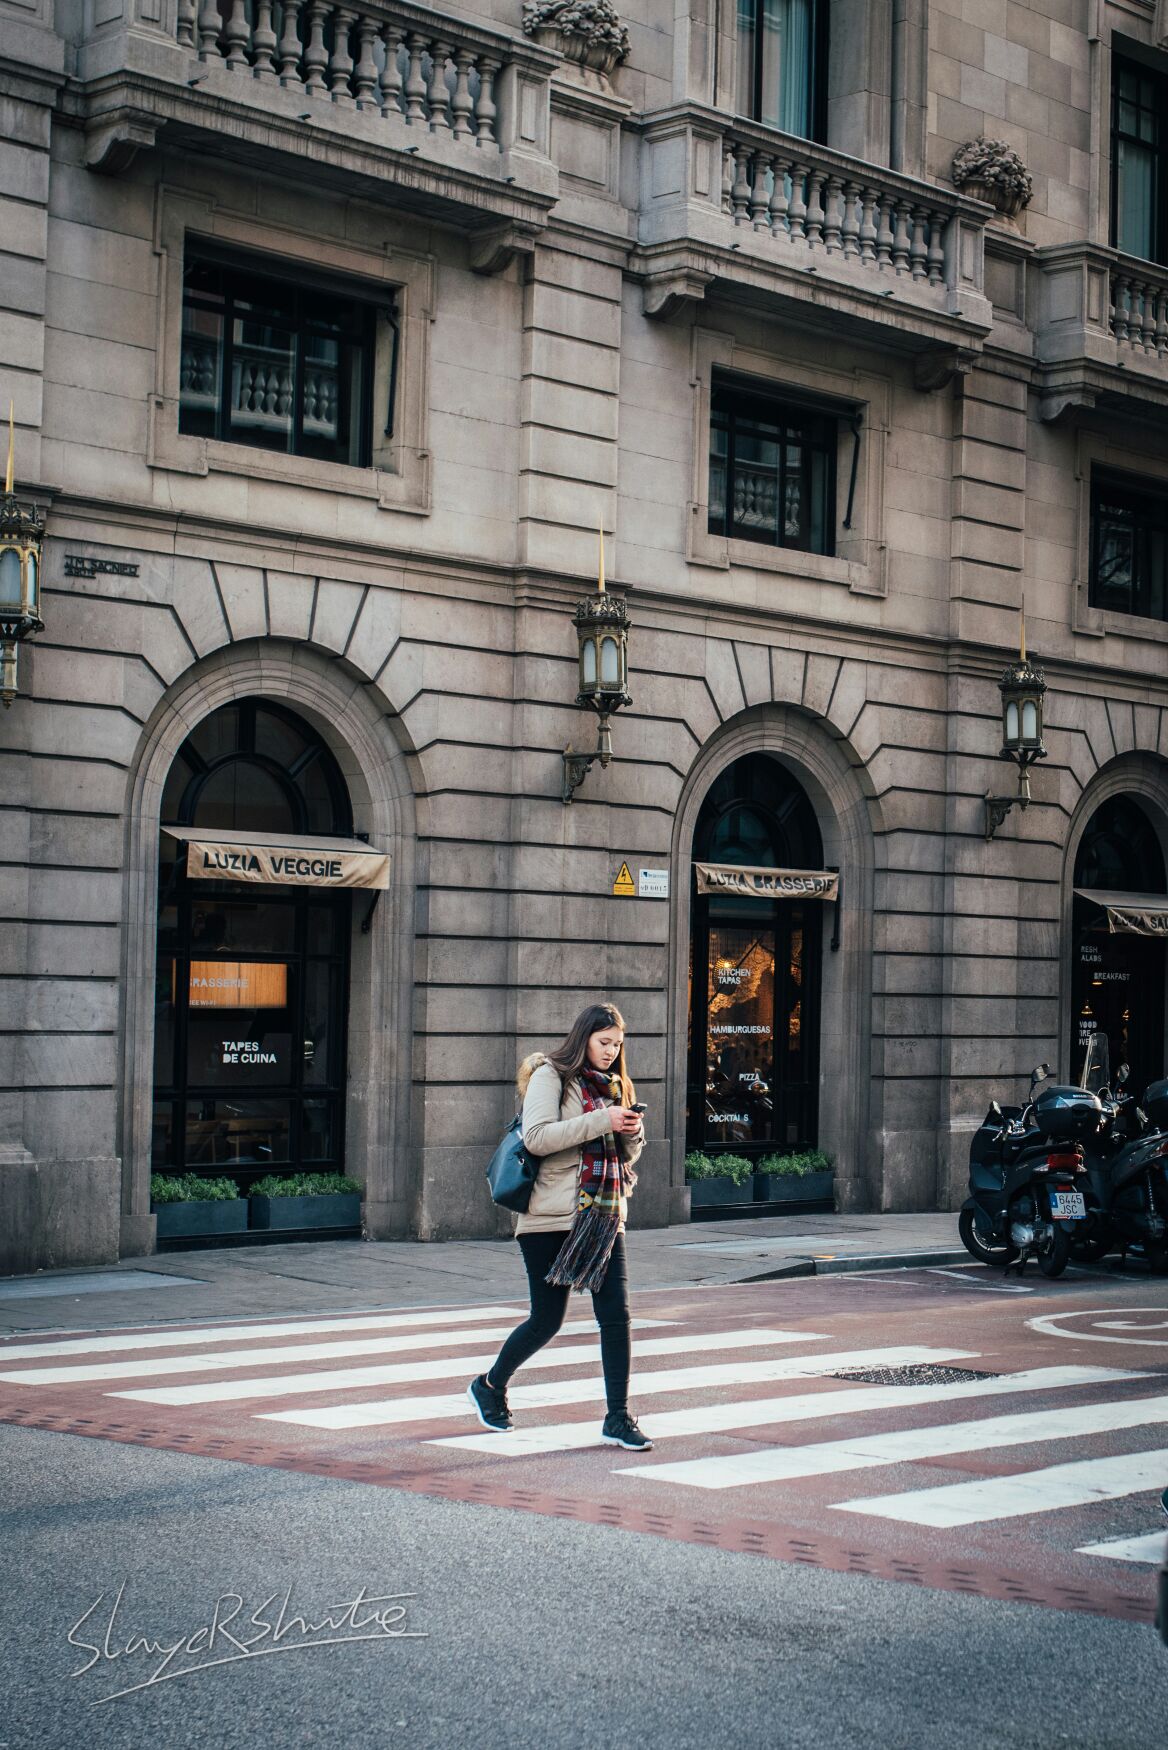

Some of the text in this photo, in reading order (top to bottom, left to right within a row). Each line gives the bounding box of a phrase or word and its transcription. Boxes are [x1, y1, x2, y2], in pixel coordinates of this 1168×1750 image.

[203, 851, 343, 878] LUZIA VEGGIE
[706, 872, 835, 892] LUZIA BRASSERIE
[718, 968, 751, 977] KITCHEN
[1093, 972, 1130, 981] BREAKFAST
[718, 976, 741, 984] TAPAS
[709, 1025, 771, 1034] HAMBURGUESAS
[222, 1041, 259, 1051] TAPES
[222, 1053, 277, 1063] DE CUINA
[739, 1073, 760, 1081] PIZZA
[708, 1113, 749, 1123] COCKTAIS
[1058, 1194, 1082, 1205] 6445
[1060, 1204, 1078, 1215] JSC
